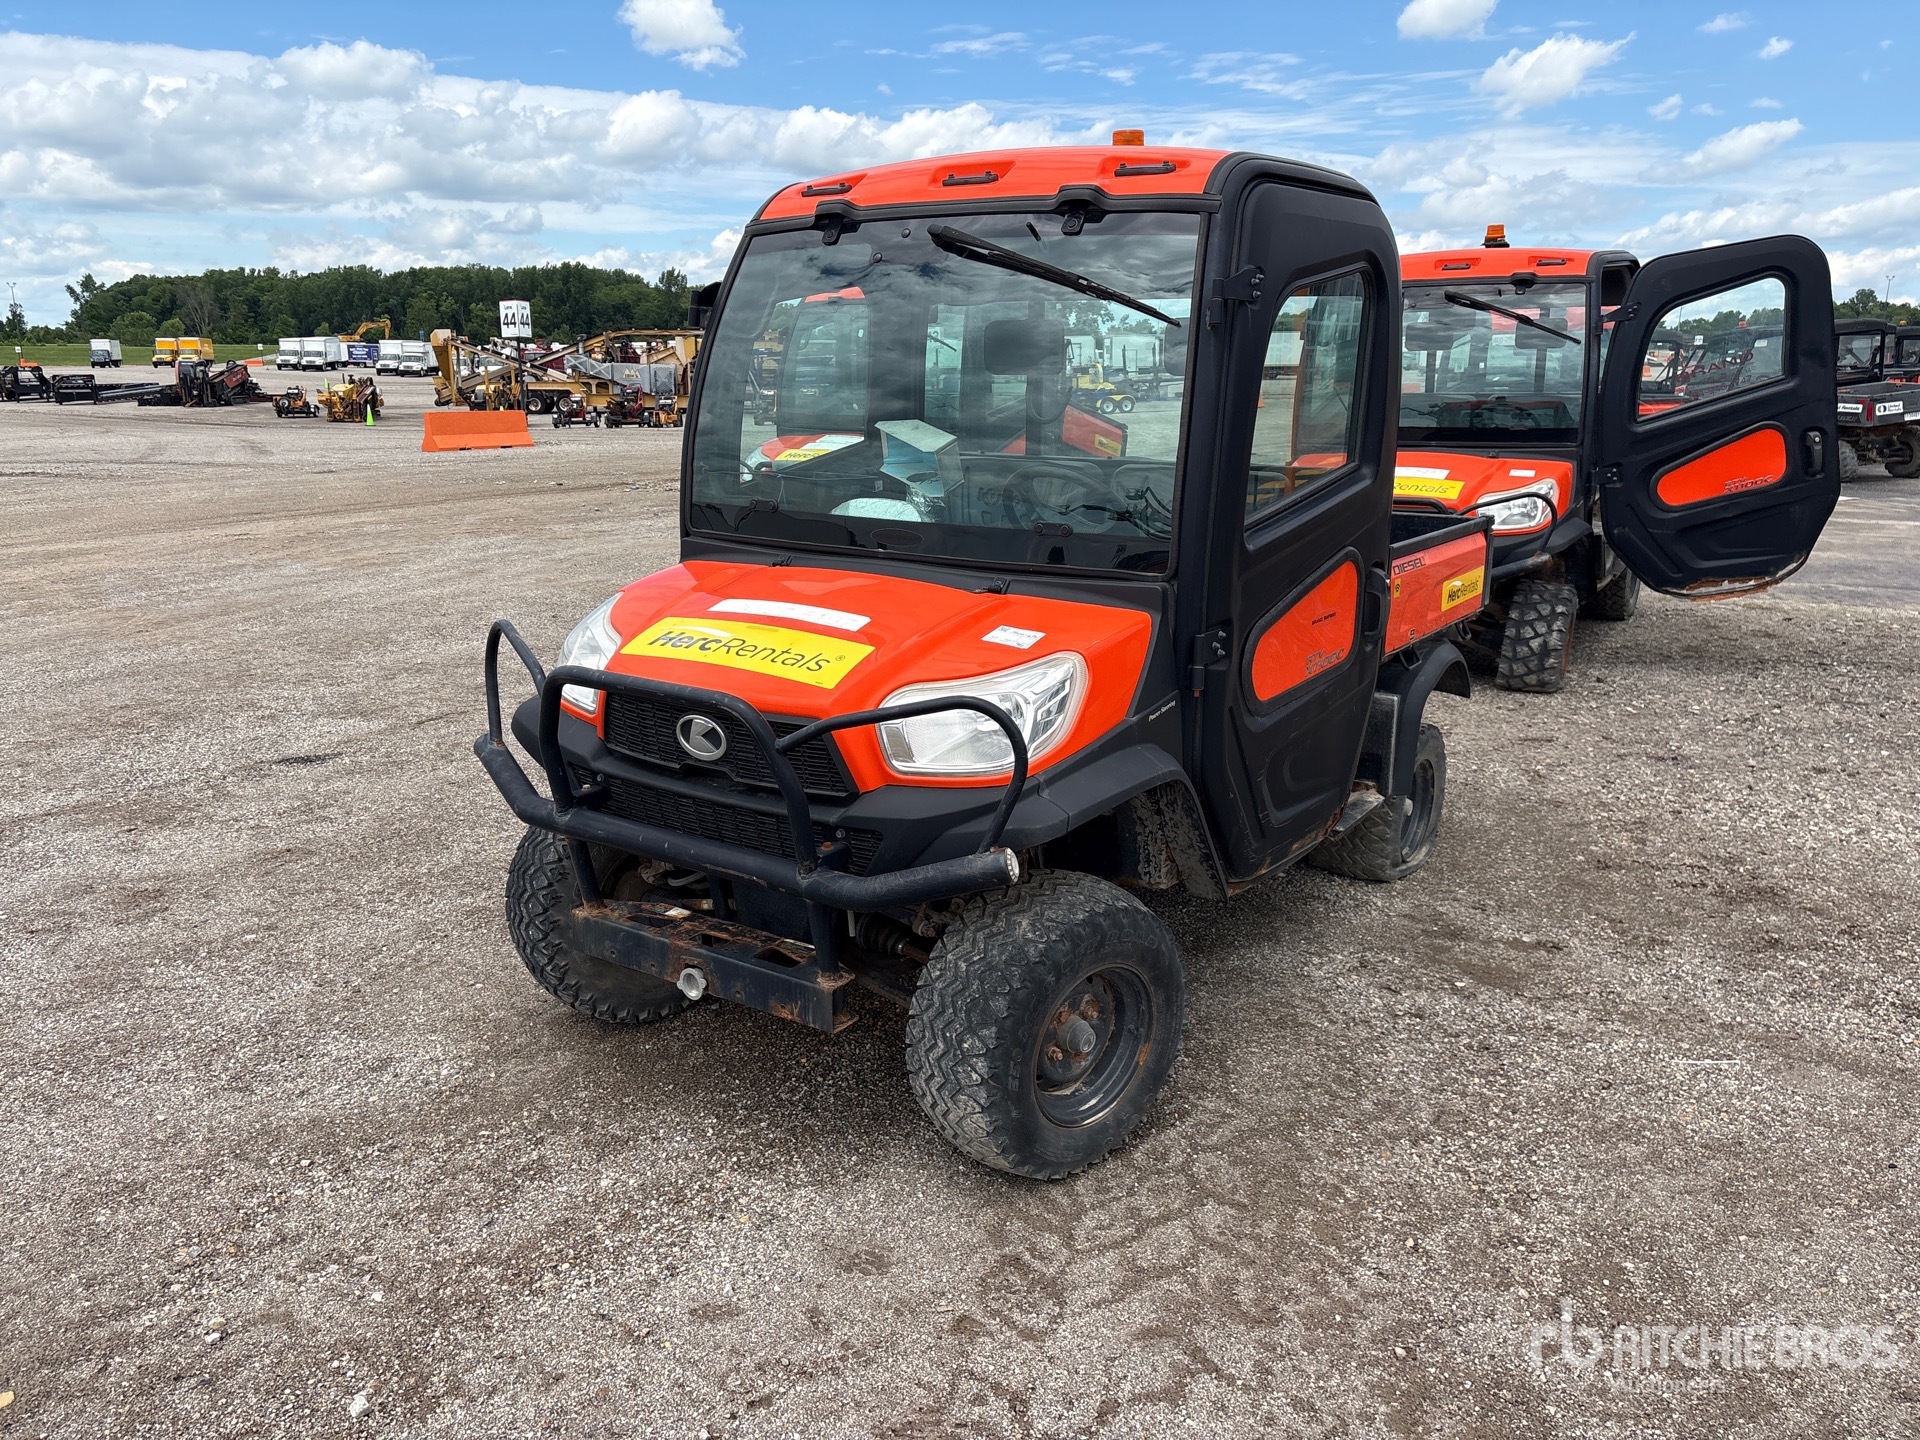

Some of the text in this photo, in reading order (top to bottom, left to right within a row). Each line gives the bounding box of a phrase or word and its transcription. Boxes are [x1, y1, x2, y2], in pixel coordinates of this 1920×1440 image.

[502, 312, 517, 329] 44
[519, 312, 531, 329] 44
[1393, 556, 1427, 576] DIESEL
